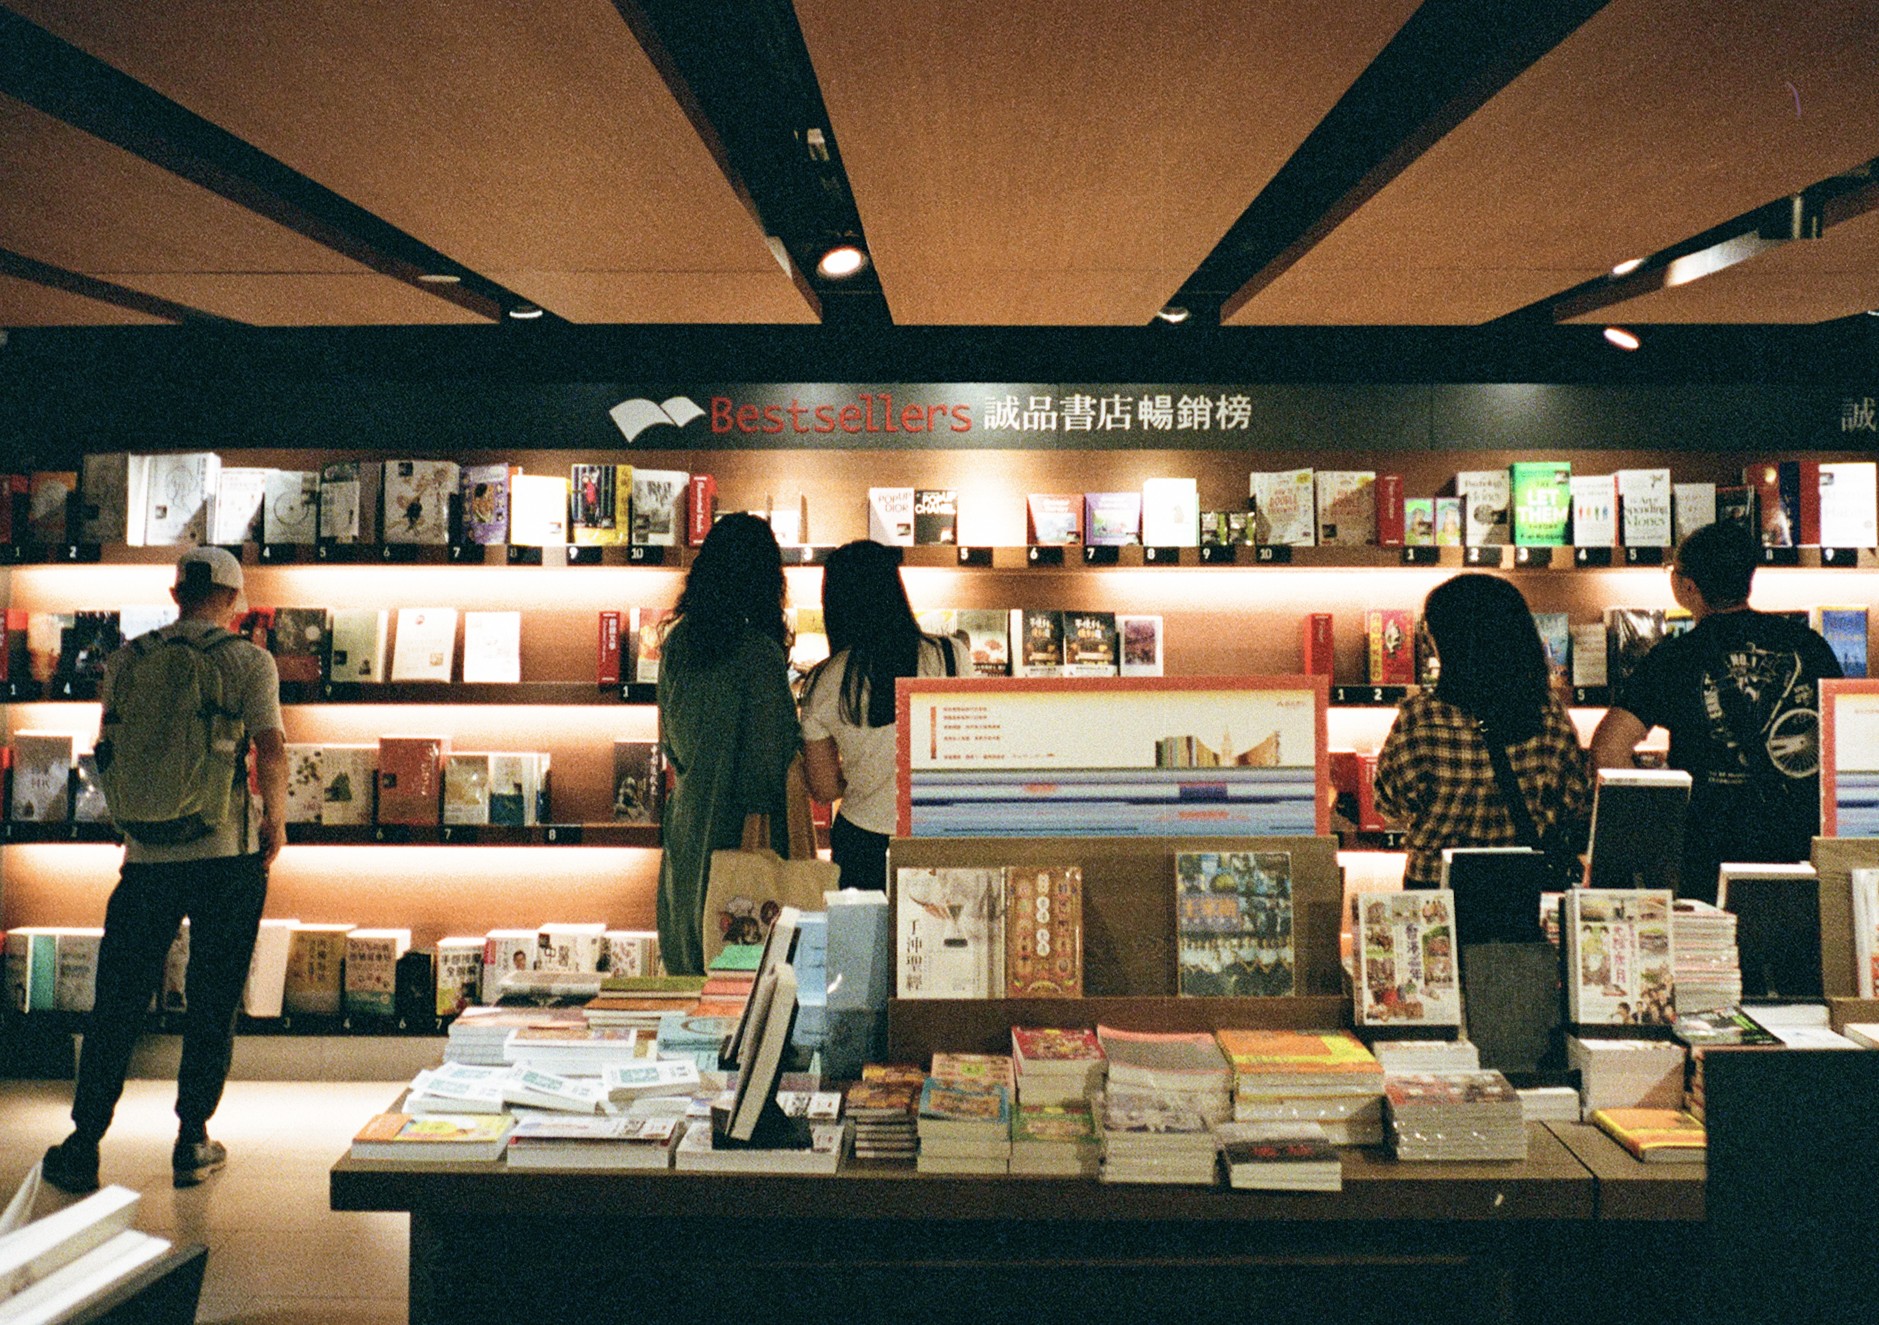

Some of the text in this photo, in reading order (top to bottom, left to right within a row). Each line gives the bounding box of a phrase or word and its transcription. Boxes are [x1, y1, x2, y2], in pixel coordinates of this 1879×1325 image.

[711, 394, 972, 434] Bestsellers
[984, 393, 1253, 432] 誠品書店暢銷榜
[1841, 396, 1877, 432] 誠
[915, 503, 957, 514] CHANEL
[1527, 488, 1560, 506] LET
[1516, 506, 1569, 522] THEM
